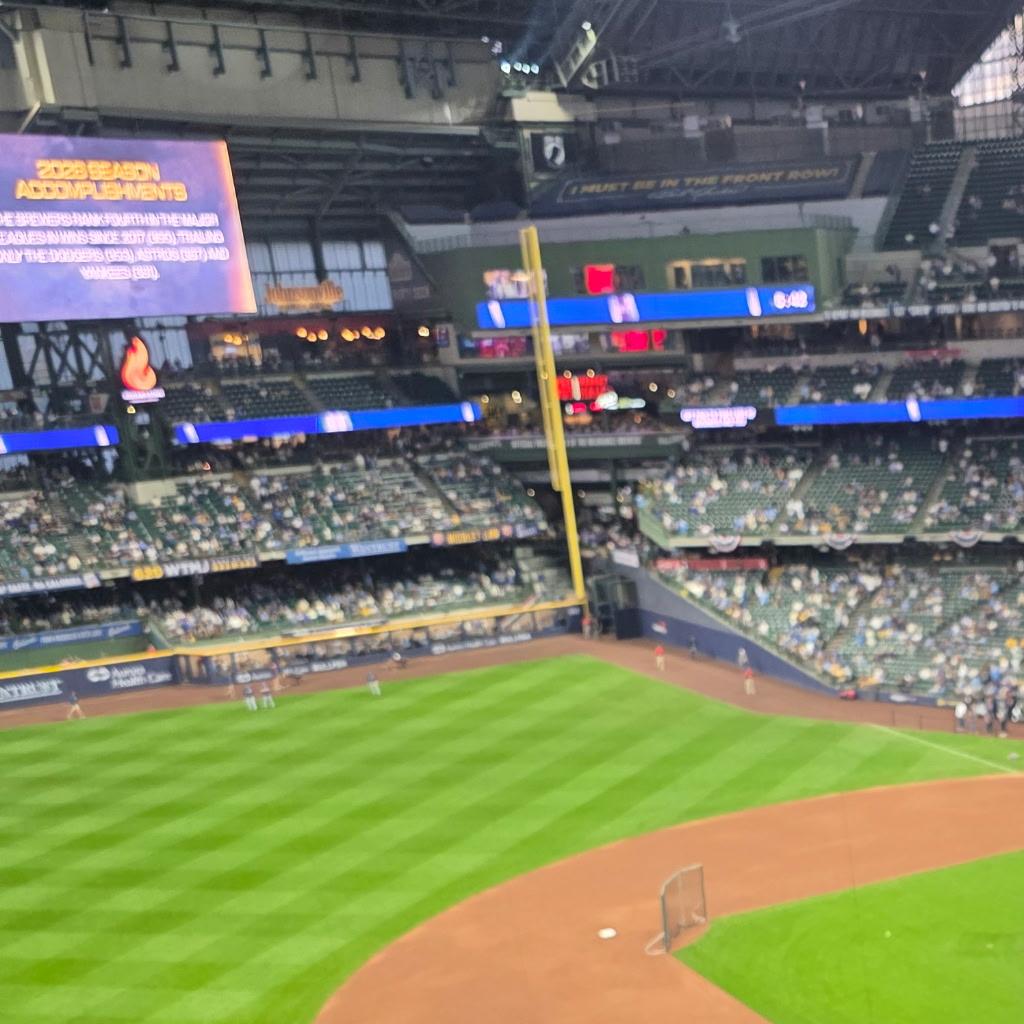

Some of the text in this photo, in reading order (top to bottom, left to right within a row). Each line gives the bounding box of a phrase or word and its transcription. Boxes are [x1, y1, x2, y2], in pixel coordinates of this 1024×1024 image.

[87, 160, 160, 181] SEASON
[15, 179, 188, 201] ACCOMPLISHMENTS
[580, 182, 628, 194] MUST
[660, 178, 680, 188] IN
[684, 175, 718, 187] THE
[720, 171, 784, 185] FRONT
